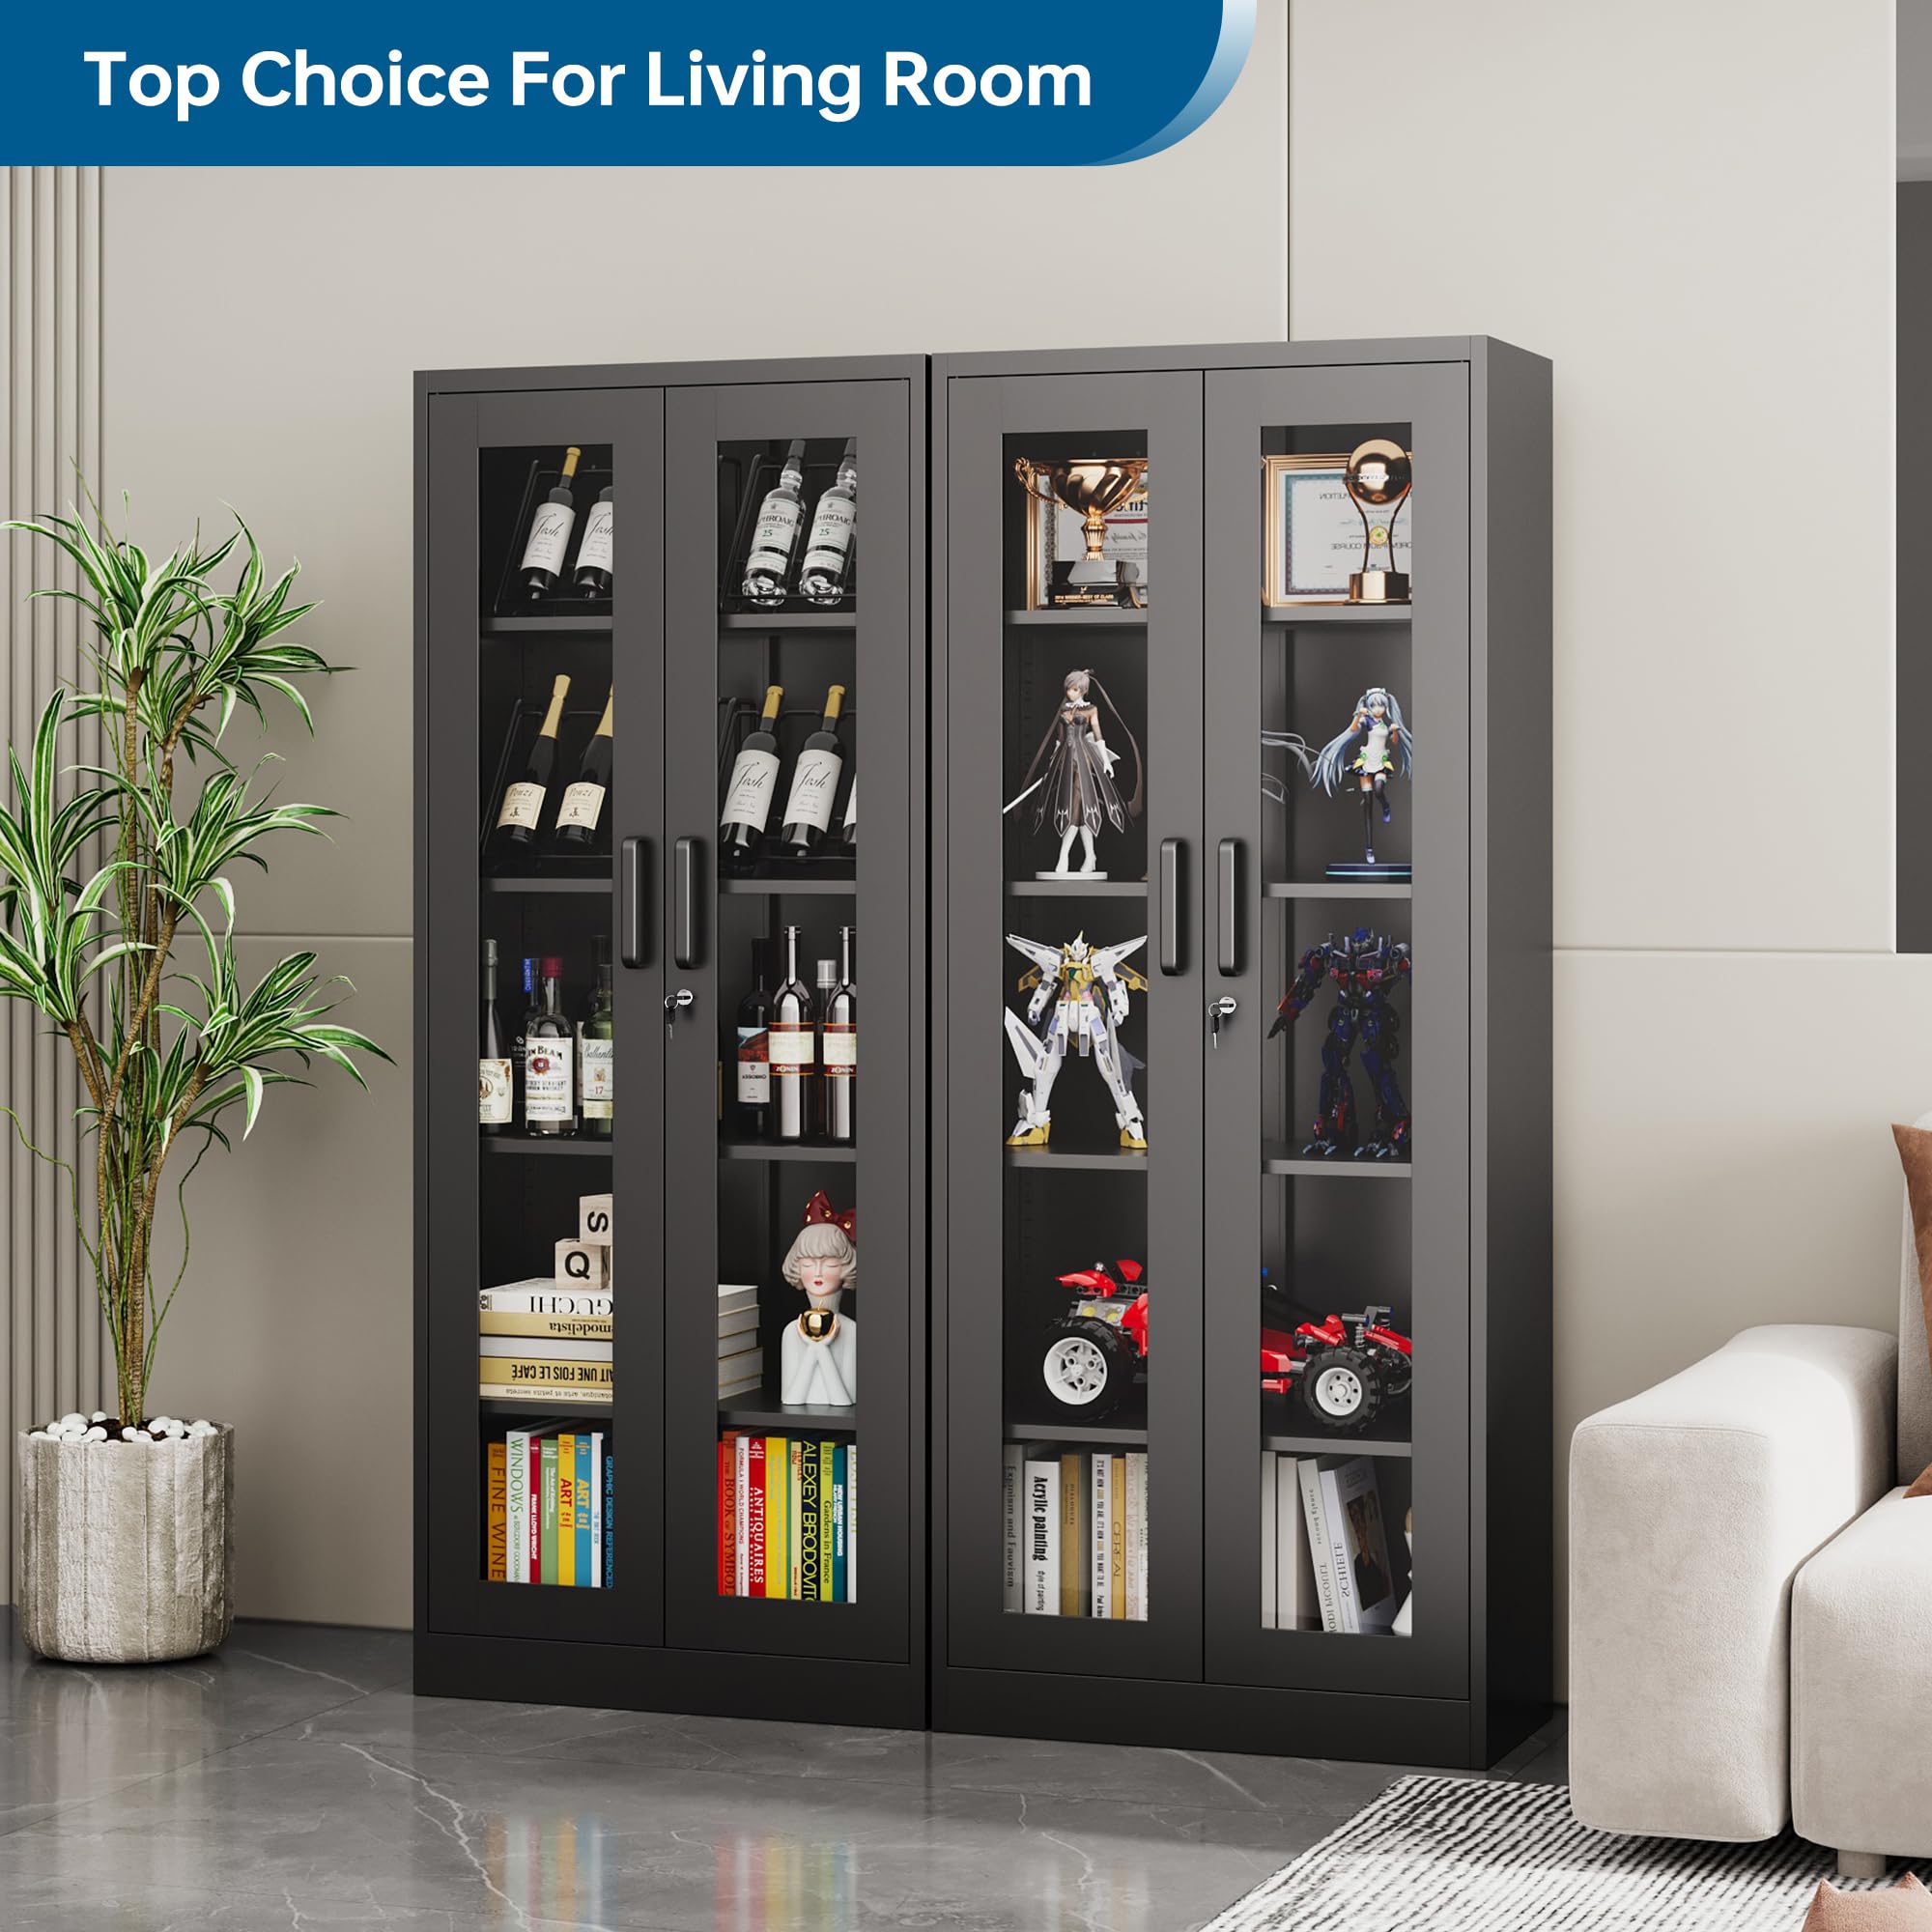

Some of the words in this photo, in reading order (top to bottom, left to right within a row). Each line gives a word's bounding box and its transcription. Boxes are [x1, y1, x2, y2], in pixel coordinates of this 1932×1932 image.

[595, 1086, 604, 1095] 17
[587, 1211, 609, 1233] S
[564, 1251, 590, 1280] Q
[511, 1364, 537, 1380] CAFÉ
[539, 1365, 551, 1379] LE
[553, 1366, 575, 1380] FOIS
[578, 1367, 598, 1381] UNE
[493, 1467, 505, 1513] FINE
[510, 1438, 524, 1513] WINDOWS
[605, 1456, 613, 1495] GRAPHIC
[803, 1440, 817, 1509] ALEXEY
[560, 1478, 572, 1507] ART
[577, 1478, 589, 1509] ART
[724, 1478, 734, 1518] BOOK
[1033, 1476, 1048, 1514] Acrylic
[605, 1496, 613, 1529] DESIGN
[823, 1500, 832, 1539] Gardens
[1007, 1519, 1016, 1538] and
[493, 1522, 505, 1578] WINE
[753, 1487, 763, 1583] ANTIQUAIRES
[823, 1541, 832, 1550] in
[1033, 1516, 1048, 1561] painting
[605, 1530, 613, 1589] REFERENCED
[823, 1552, 832, 1583] France
[1007, 1542, 1016, 1587] Fauvism
